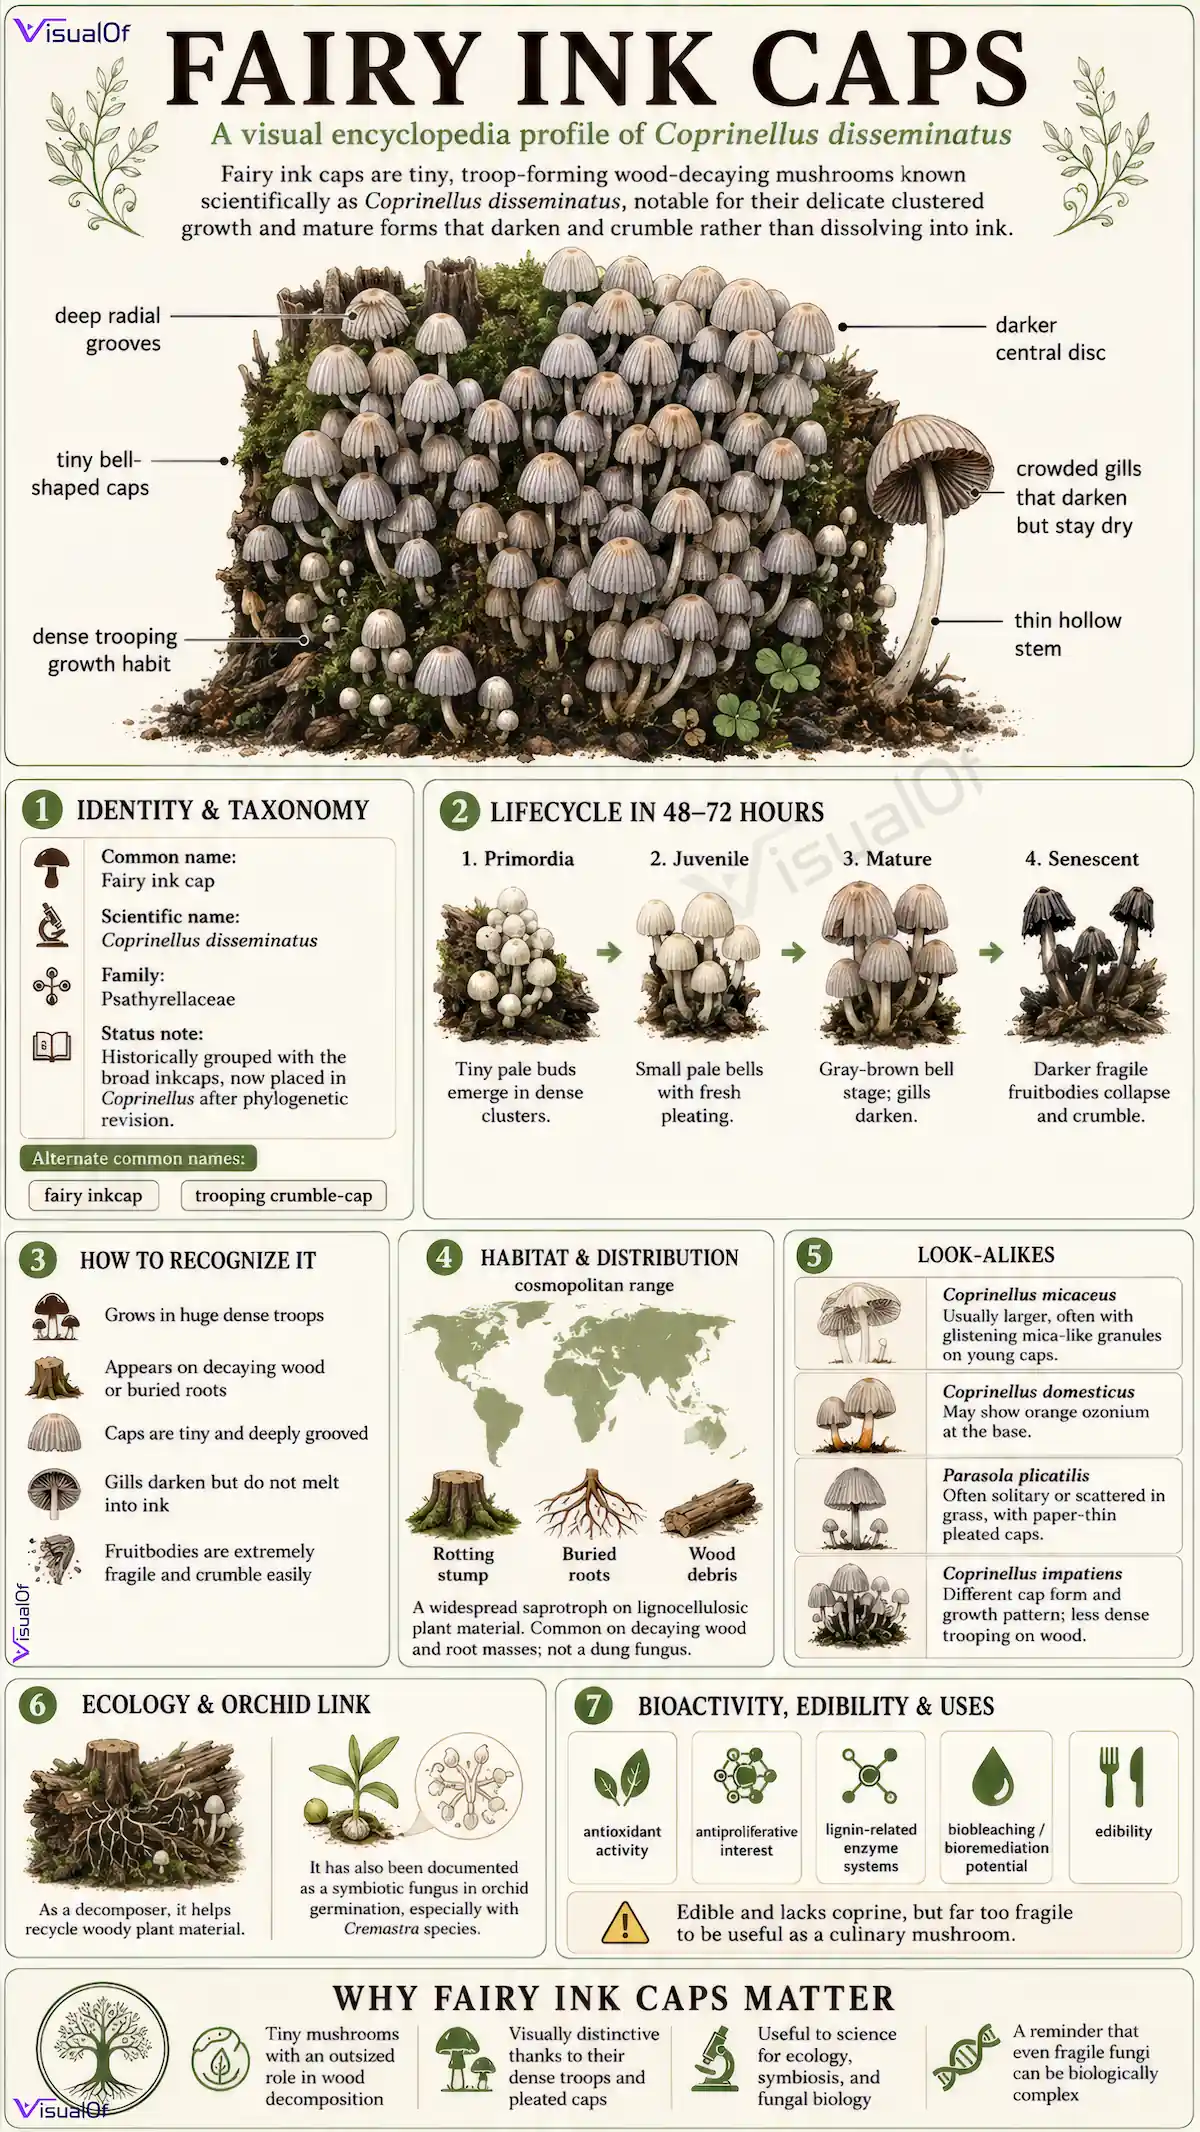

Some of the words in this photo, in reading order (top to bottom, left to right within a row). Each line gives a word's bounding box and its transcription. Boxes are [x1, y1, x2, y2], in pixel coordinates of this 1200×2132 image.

[166, 30, 482, 105] FAIRY
[517, 31, 717, 106] INK
[752, 30, 1027, 107] CAPS
[211, 122, 232, 144] A
[241, 121, 322, 145] visual
[332, 121, 511, 152] encyclopedia
[520, 121, 609, 152] profile
[619, 122, 647, 145] of
[656, 121, 818, 152] Coprinellus
[829, 121, 1012, 145] disseminatus
[221, 165, 273, 187] Fairy
[281, 165, 312, 182] ink
[319, 170, 364, 188] caps
[371, 170, 402, 182] are
[409, 165, 453, 187] tiny,
[462, 165, 608, 187] troop-forming
[614, 165, 770, 188] wood-decaying
[776, 165, 894, 182] mushrooms
[901, 165, 966, 182] known
[55, 306, 101, 328] deep
[109, 306, 160, 324] radial
[996, 316, 1057, 333] darker
[86, 339, 161, 356] grooves
[996, 343, 1061, 360] central
[1068, 343, 1106, 360] disc
[57, 451, 93, 472] tiny
[100, 450, 141, 468] bell-
[1017, 459, 1098, 477] crowded
[1105, 459, 1141, 481] gills
[32, 478, 99, 500] shaped
[107, 483, 149, 500] caps
[1016, 488, 1055, 506] that
[1062, 488, 1126, 506] darken
[1018, 516, 1049, 534] but
[1056, 518, 1095, 538] stay
[1102, 516, 1133, 538] dry
[1014, 611, 1051, 628] thin
[1059, 611, 1122, 628] hollow
[33, 627, 88, 644] dense
[95, 627, 177, 649] trooping
[1015, 642, 1061, 656] stem
[48, 654, 115, 676] growth
[123, 654, 171, 672] habit
[36, 797, 48, 821] 1
[77, 800, 193, 820] IDENTITY
[202, 800, 220, 820] &
[228, 800, 369, 820] TAXONOMY
[452, 799, 468, 823] 2
[491, 801, 622, 822] LIFECYCLE
[630, 802, 656, 822] IN
[663, 802, 731, 822] 48–72
[740, 801, 824, 822] HOURS
[101, 849, 179, 864] Common
[185, 853, 235, 864] name:
[463, 851, 477, 866] 1.
[485, 850, 574, 866] Primordia
[651, 851, 666, 866] 2.
[673, 851, 749, 866] Juvenile
[844, 851, 858, 866] 3.
[867, 851, 931, 866] Mature
[1025, 850, 1041, 866] 4.
[1049, 851, 1139, 866] Senescent
[102, 908, 182, 924] Scientific
[188, 913, 239, 924] name:
[102, 932, 200, 951] Coprinellus
[206, 932, 318, 947] disseminatus
[102, 967, 164, 986] Family:
[102, 991, 235, 1010] Psathyrellaceae
[102, 1025, 154, 1041] Status
[160, 1028, 203, 1040] note:
[33, 1151, 108, 1165] Alternate
[114, 1155, 182, 1165] common
[189, 1155, 245, 1165] names:
[45, 1187, 83, 1206] fairy
[88, 1188, 142, 1206] inkcap
[196, 1188, 265, 1206] trooping
[270, 1188, 372, 1206] crumble-cap
[31, 1248, 45, 1271] 3
[80, 1251, 130, 1269] HOW
[136, 1251, 164, 1269] TO
[169, 1251, 290, 1269] RECOGNIZE
[296, 1251, 316, 1269] IT
[436, 1246, 452, 1268] 4
[481, 1249, 569, 1266] HABITAT
[576, 1249, 590, 1266] &
[597, 1249, 739, 1266] DISTRIBUTION
[807, 1244, 821, 1267] 5
[918, 1246, 1054, 1263] LOOK-ALIKES
[943, 1287, 1037, 1305] Coprinellus
[1042, 1288, 1116, 1301] micaceus
[105, 1307, 155, 1322] Grows
[160, 1308, 175, 1322] in
[180, 1307, 219, 1326] huge
[223, 1307, 269, 1322] dense
[274, 1310, 324, 1326] troops
[943, 1384, 1037, 1402] Coprinellus
[1043, 1384, 1135, 1399] domesticus
[943, 1468, 1013, 1482] Parasola
[1018, 1468, 1089, 1486] plicatilis
[433, 1546, 494, 1565] Rotting
[563, 1546, 616, 1561] Buried
[689, 1546, 735, 1561] Wood
[438, 1569, 489, 1585] stump
[569, 1569, 610, 1581] roots
[688, 1567, 737, 1581] debris
[943, 1566, 1037, 1585] Coprinellus
[1042, 1567, 1122, 1584] impatiens
[30, 1693, 46, 1716] 6
[82, 1694, 190, 1714] ECOLOGY
[197, 1694, 214, 1714] &
[222, 1694, 311, 1714] ORCHID
[318, 1694, 371, 1714] LINK
[587, 1694, 601, 1717] 7
[639, 1696, 788, 1719] BIOACTIVITY,
[796, 1696, 909, 1716] EDIBILITY
[916, 1696, 932, 1716] &
[940, 1696, 994, 1716] USES
[584, 1825, 661, 1837] antioxidant
[696, 1825, 798, 1841] antiproliferative
[826, 1823, 917, 1839] lignin-related
[949, 1823, 1035, 1839] biobleaching
[1039, 1823, 1045, 1837] /
[1095, 1824, 1152, 1841] edibility
[596, 1844, 648, 1859] activity
[721, 1844, 773, 1856] interest
[844, 1845, 898, 1857] enzyme
[945, 1841, 1049, 1854] bioremediation
[844, 1861, 898, 1875] systems
[966, 1859, 1027, 1875] potential
[677, 1904, 734, 1920] Edible
[741, 1904, 774, 1920] and
[781, 1904, 826, 1920] lacks
[832, 1904, 907, 1924] coprine,
[913, 1904, 943, 1919] but
[949, 1904, 974, 1919] far
[980, 1906, 1009, 1920] too
[1016, 1904, 1073, 1924] fragile
[344, 1922, 419, 1935] Cremastra
[424, 1922, 480, 1938] species.
[332, 1985, 418, 2011] WHY
[434, 1985, 539, 2011] FAIRY
[555, 1985, 620, 2011] INK
[636, 1985, 727, 2011] CAPS
[744, 1985, 895, 2011] MATTER
[265, 2027, 301, 2045] Tiny
[307, 2026, 399, 2041] mushrooms
